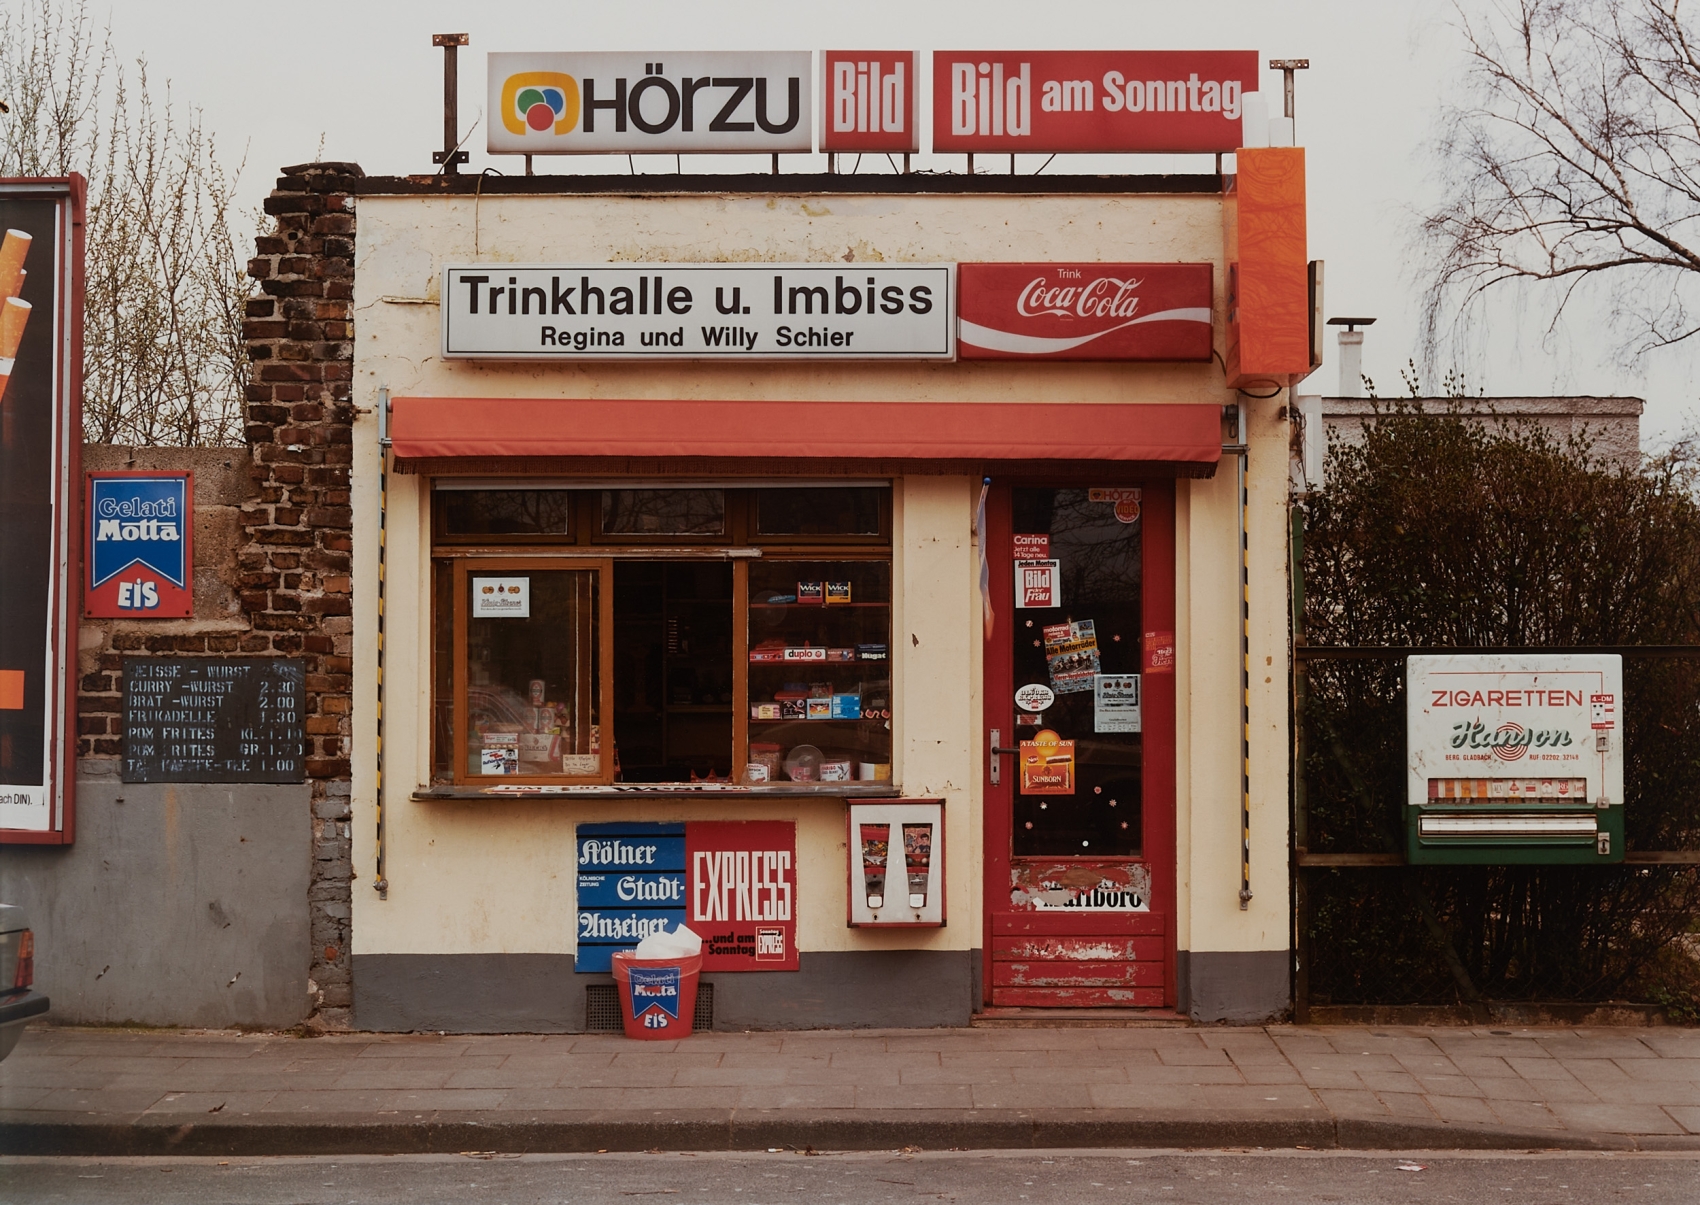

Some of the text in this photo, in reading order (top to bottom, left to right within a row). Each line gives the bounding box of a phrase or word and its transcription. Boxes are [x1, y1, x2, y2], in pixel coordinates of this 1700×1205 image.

[833, 62, 904, 133] Bild
[952, 62, 1242, 136] Bild am Sonntag
[1057, 269, 1082, 279] Trink
[460, 275, 933, 315] Trinkhalle u. Imbiss
[1017, 277, 1145, 317] Coca-Cola
[541, 326, 854, 351] Regina und Willy Schier
[98, 497, 177, 518] Gelati
[1115, 505, 1140, 514] VIDEO
[97, 518, 180, 541] Motta
[1013, 534, 1048, 545] Carina
[1035, 560, 1057, 568] Montag
[1025, 570, 1050, 589] Bild
[1025, 588, 1050, 603] Frau
[788, 648, 813, 659] duplo
[1046, 646, 1059, 655] Alle
[1059, 640, 1096, 653] Motorräder
[207, 665, 251, 678] WURST
[129, 681, 173, 693] CURRY
[260, 681, 295, 693] 2.30
[129, 695, 163, 708] BRAT
[259, 696, 295, 708] 2.00
[1431, 690, 1583, 707] ZIGARETTEN
[129, 710, 216, 723] FRIKADELLE
[261, 711, 296, 723] 1.30
[128, 727, 215, 740] POM FRITES
[1451, 720, 1573, 749] Hanson
[261, 759, 295, 771] 1.00
[1032, 774, 1062, 783] SUNBORN
[14, 793, 33, 805] DIN).
[579, 840, 657, 865] Kölner
[617, 875, 685, 901] Stadt-
[693, 851, 791, 922] EXPRESS
[579, 912, 669, 939] Anzeiger
[737, 935, 755, 944] am
[758, 935, 783, 954] EXPRESS
[708, 944, 756, 957] Sonntag
